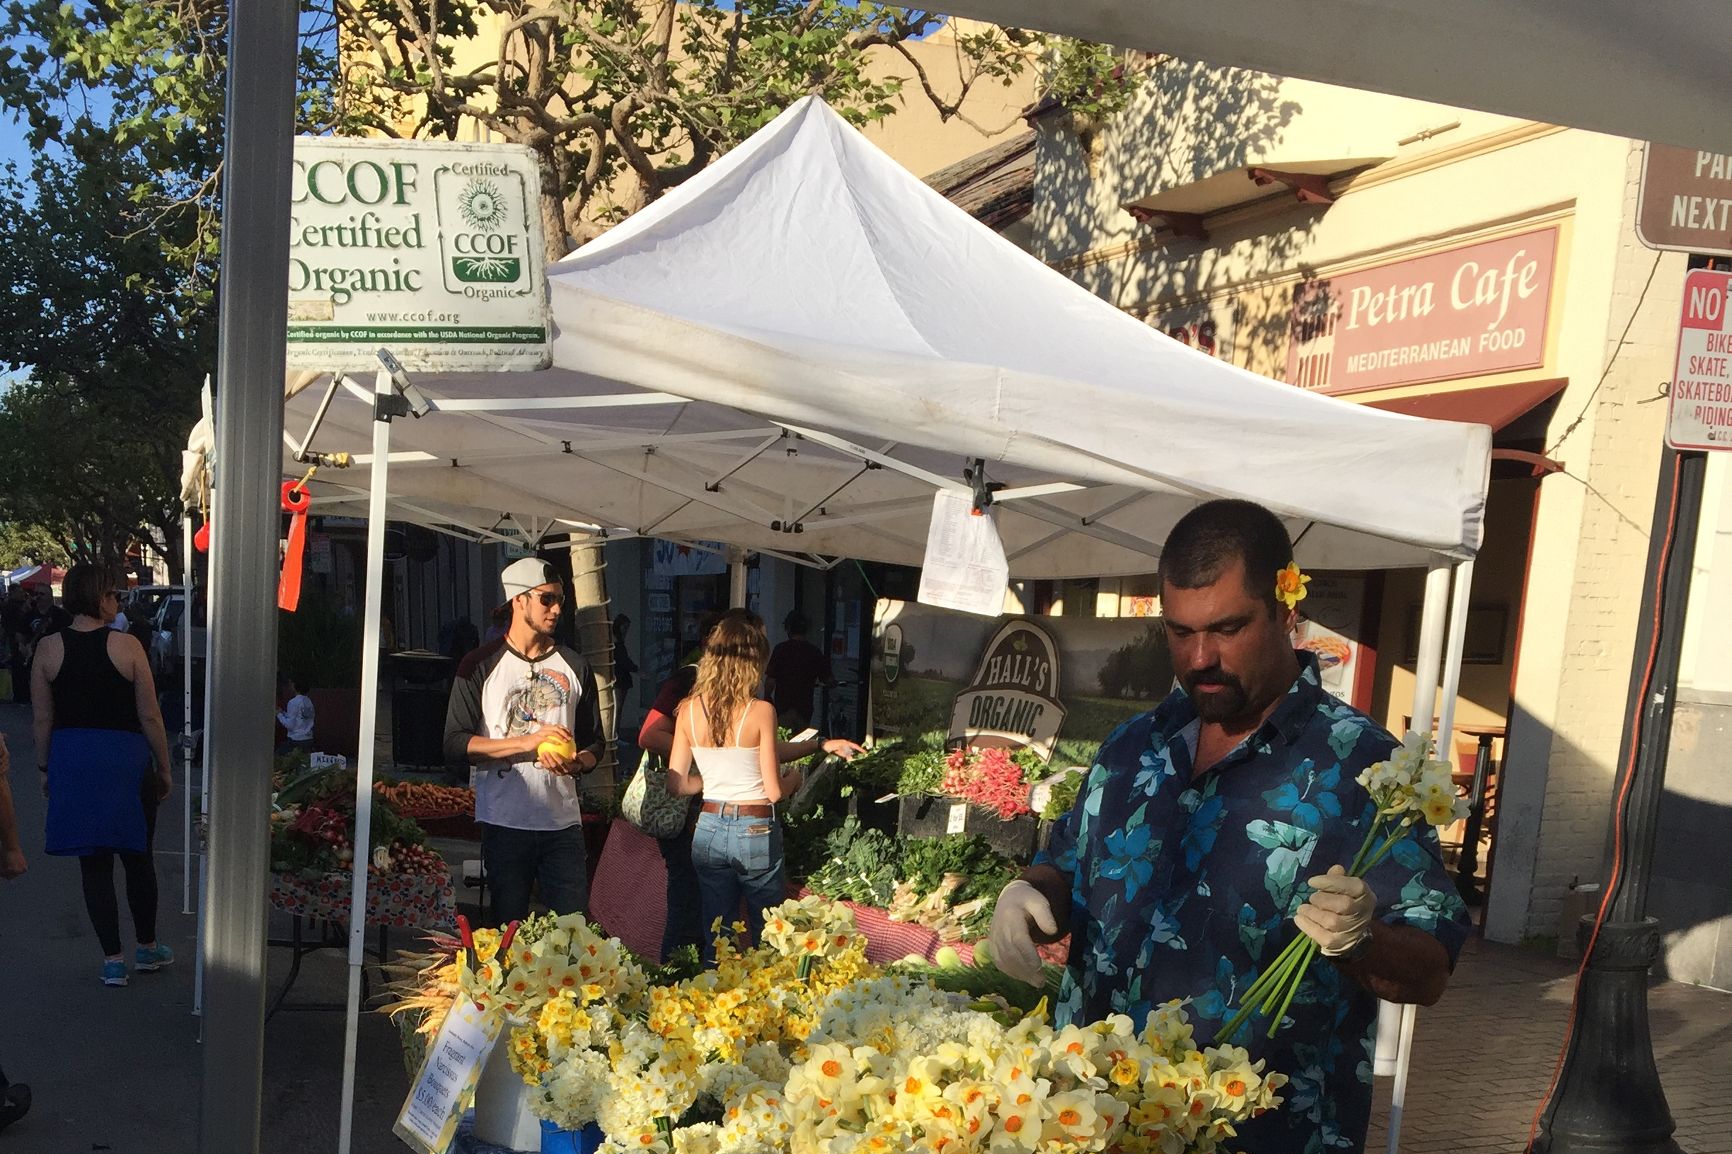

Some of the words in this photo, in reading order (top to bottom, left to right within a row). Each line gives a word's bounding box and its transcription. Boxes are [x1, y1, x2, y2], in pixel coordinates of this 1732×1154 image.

[452, 161, 509, 176] Certified
[1671, 194, 1732, 231] NEXT
[454, 233, 518, 255] CCOF
[464, 286, 516, 302] Organic
[1346, 281, 1435, 330] Petra
[1450, 250, 1539, 330] Cafe
[1689, 287, 1722, 320] NO
[366, 311, 460, 324] www.ccof.org
[315, 331, 340, 340] organic
[340, 330, 349, 340] by
[350, 330, 368, 339] CCOF
[368, 330, 376, 338] in
[413, 330, 428, 339] with
[428, 330, 439, 339] the
[440, 330, 458, 339] USDA
[459, 330, 486, 339] National
[487, 331, 511, 340] Organic
[1347, 337, 1471, 374] MEDITERRANEAN
[1479, 328, 1526, 353] FOOD
[1689, 355, 1730, 379] SKATE,
[1677, 380, 1732, 404] SKATEBO
[987, 654, 1049, 692] HALL'S
[968, 695, 1044, 738] ORGANIC
